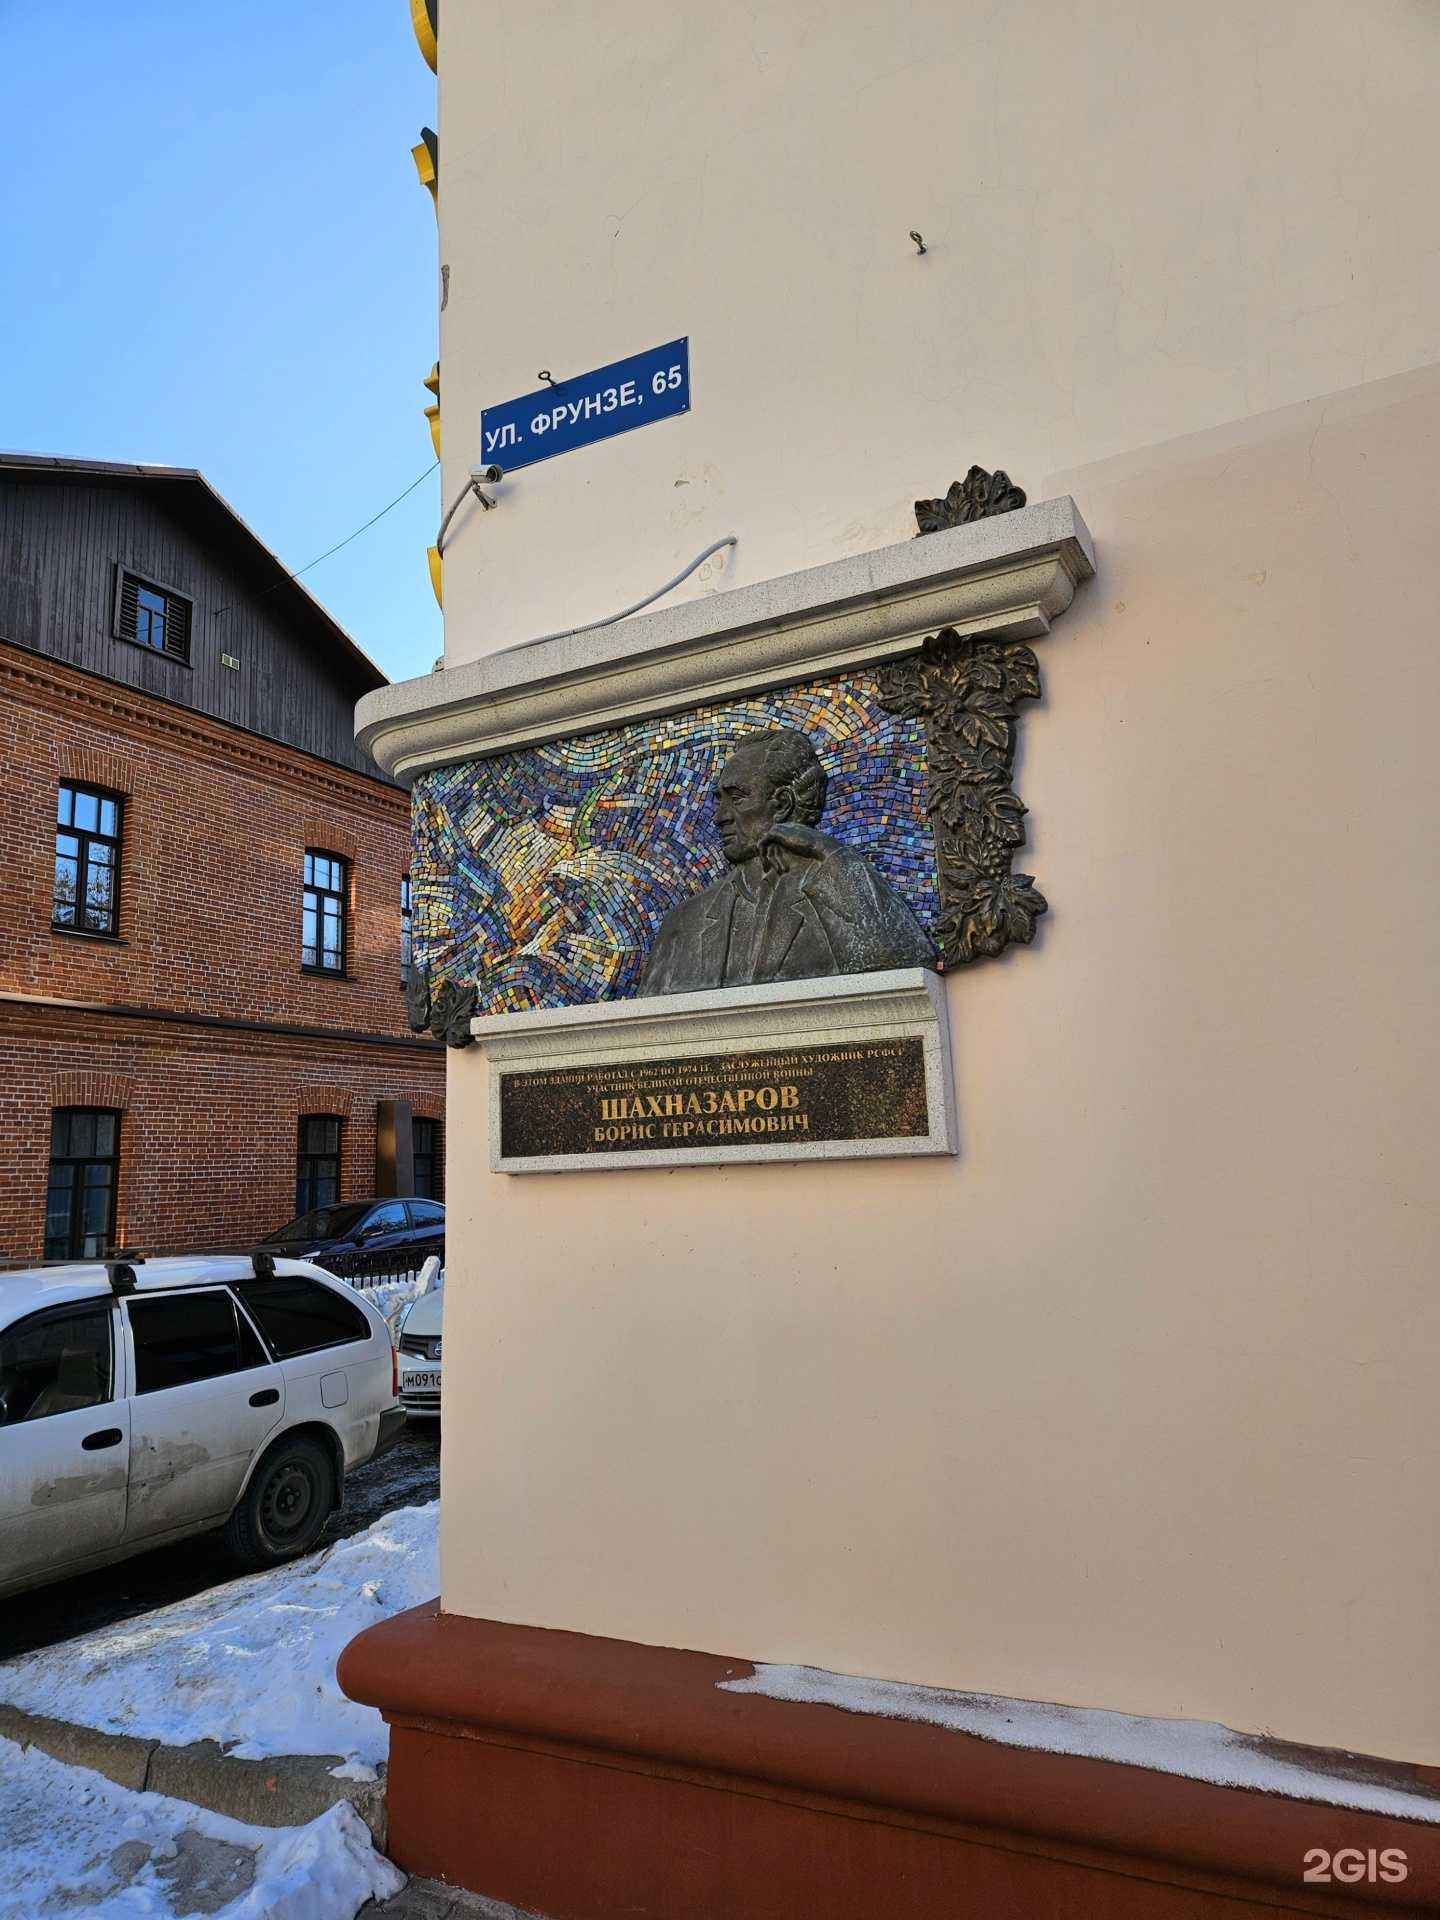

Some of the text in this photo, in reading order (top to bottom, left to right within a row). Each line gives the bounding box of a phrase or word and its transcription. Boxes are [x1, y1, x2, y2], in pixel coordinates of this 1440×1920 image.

[485, 364, 682, 453] УЛ. ФРУНЗЕ, 65
[522, 1076, 548, 1087] ЭТОМ
[587, 1068, 627, 1082] РАБОТАЛ
[640, 1066, 658, 1077] 1962
[661, 1065, 675, 1076] ПО
[678, 1063, 698, 1075] 1974
[719, 1054, 799, 1071] ЗАСЛУЖЕННЫЙ
[801, 1049, 864, 1064] ХУДОЖНИК
[867, 1046, 906, 1059] РСФСР
[586, 1067, 814, 1094] УЧАСТНИК ВЕЛИКОЙ ОТЕЧЕСТВЕННОЙ ВОЙНЫ
[601, 1085, 800, 1121] ШАХНАЗАРОВ
[594, 1114, 809, 1142] БОРИС ГЕРАСИМОВИЧ
